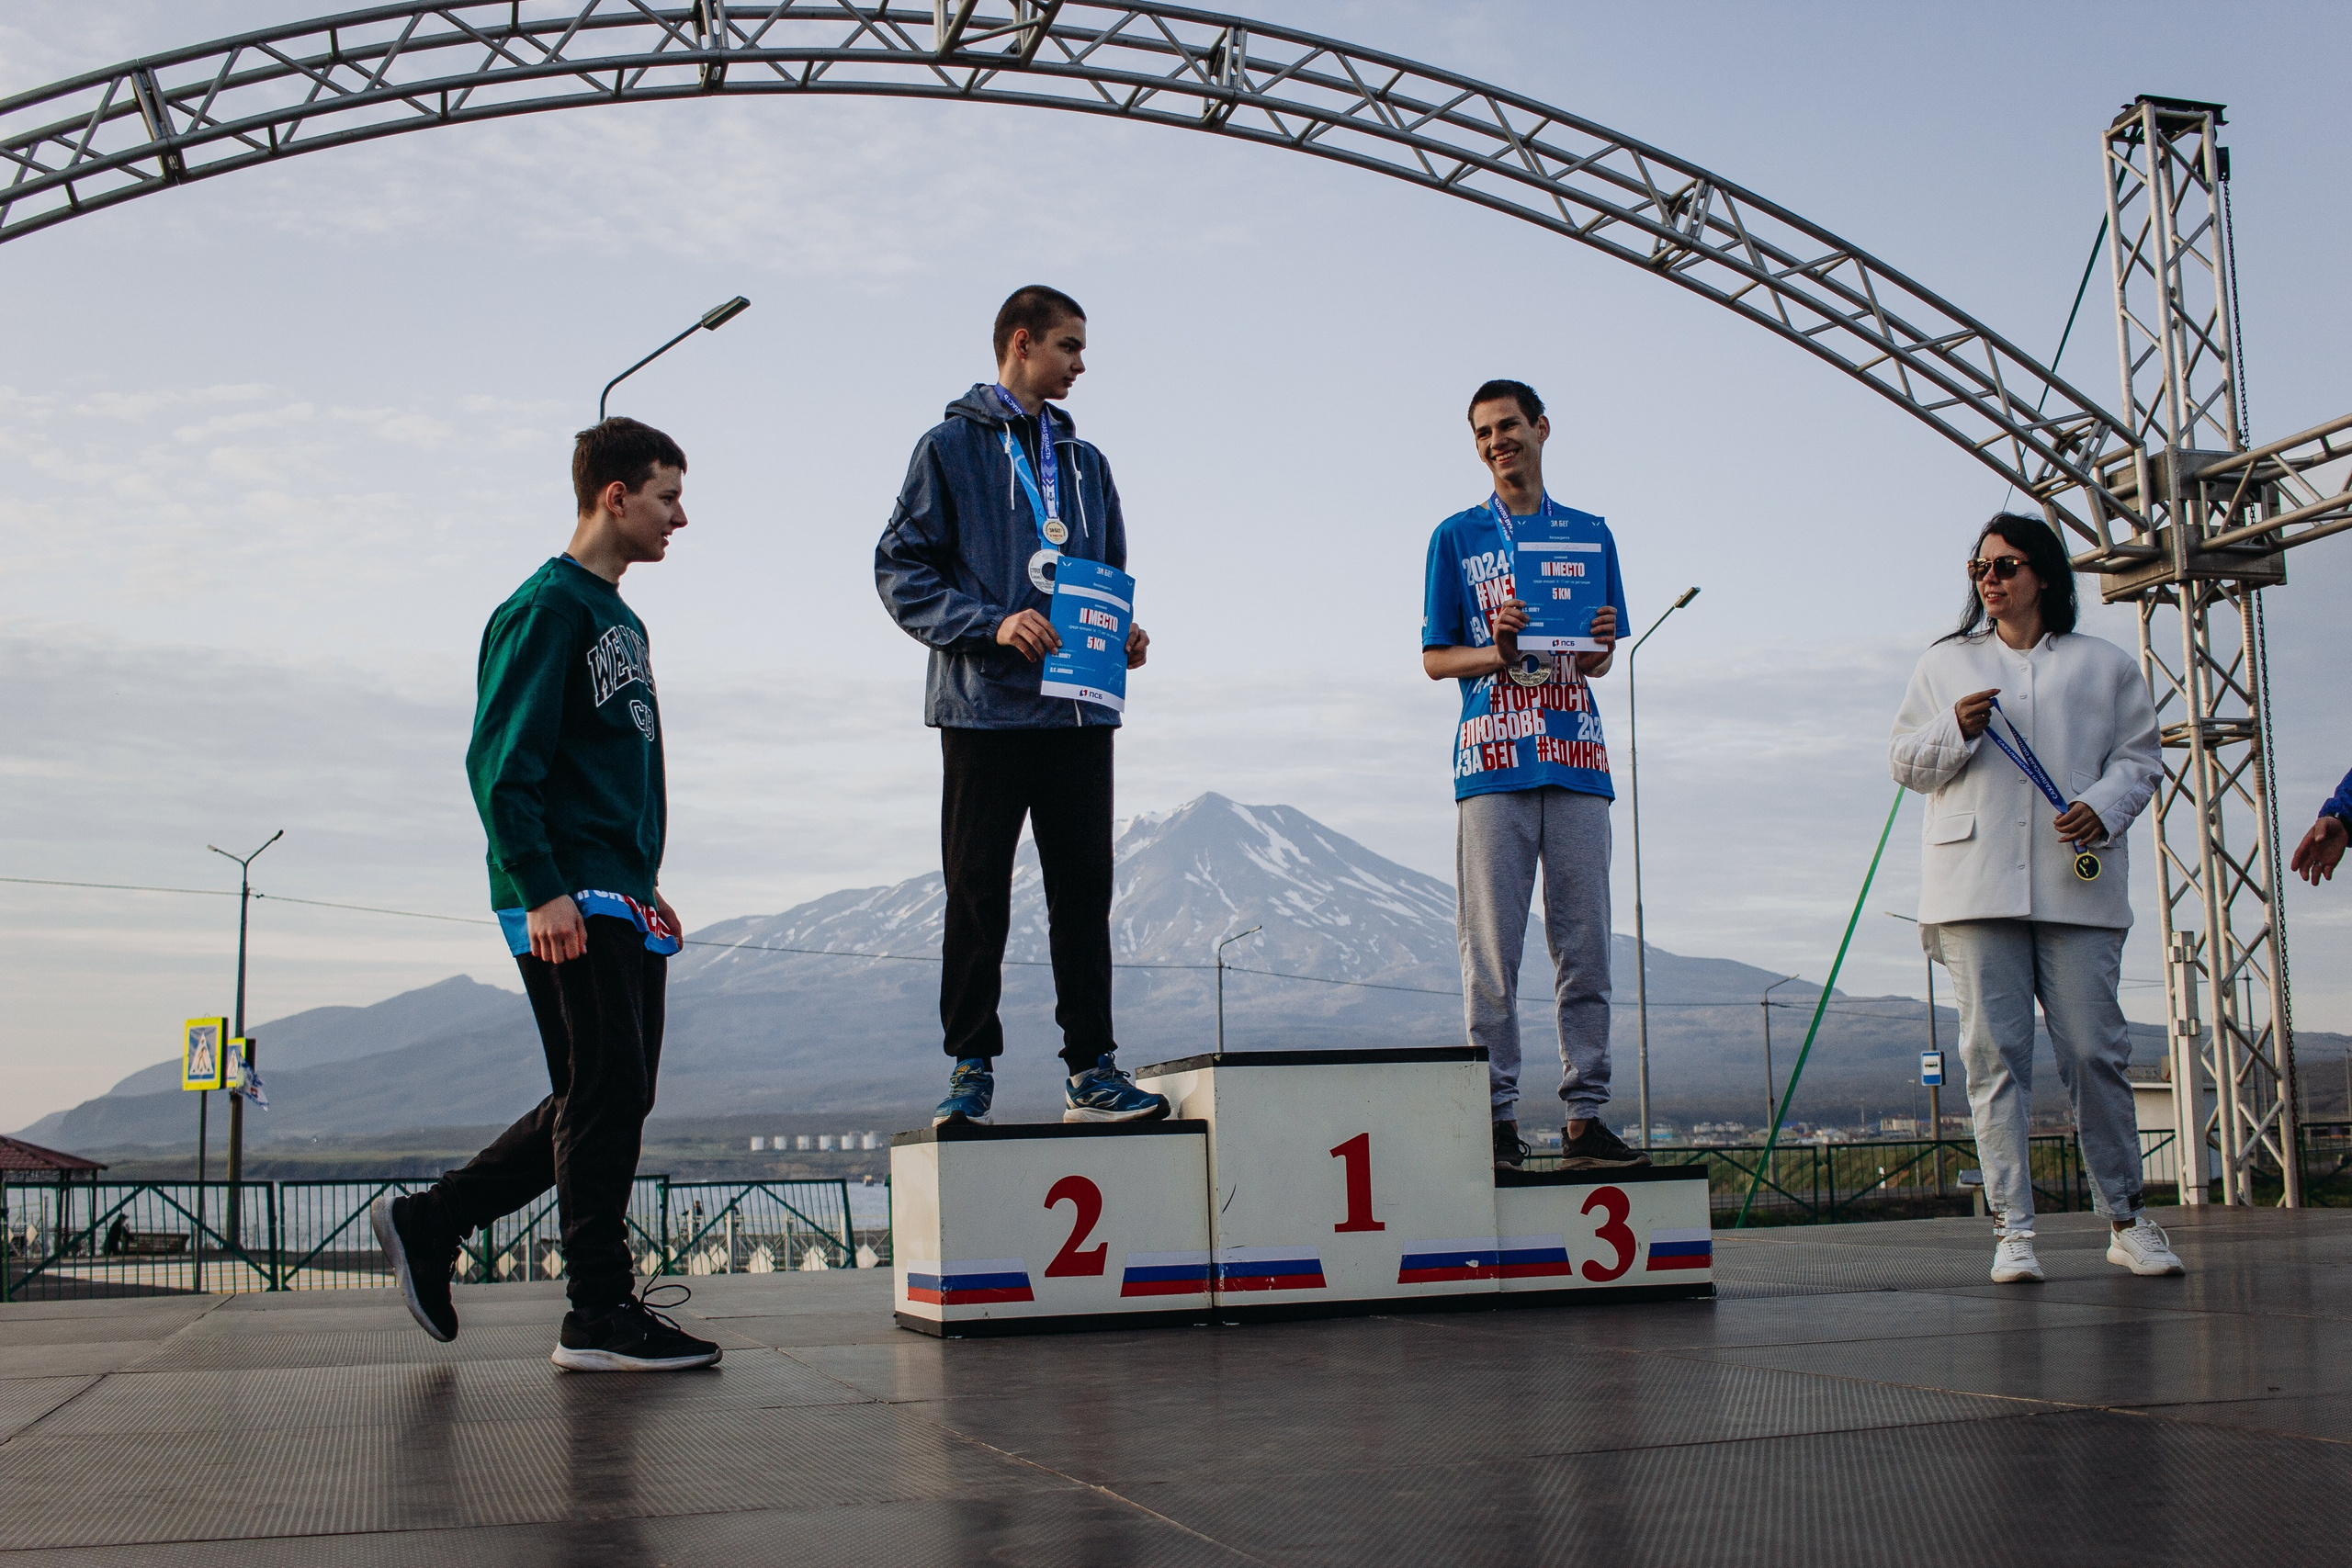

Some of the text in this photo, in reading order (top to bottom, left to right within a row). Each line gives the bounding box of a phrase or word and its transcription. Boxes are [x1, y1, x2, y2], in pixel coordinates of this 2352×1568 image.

[1462, 549, 1510, 586] 2024
[1541, 562, 1585, 577] III МЕСТО
[1552, 588, 1571, 600] 5 КМ
[1080, 607, 1118, 632] II МЕСТО
[1087, 636, 1106, 652] 5 КМ
[1089, 691, 1102, 700] ПСБ
[1460, 708, 1604, 750] #ЛЮБОВЬ 202
[1455, 741, 1519, 780] #ЗАБЕГ
[1997, 739, 2033, 775] САХАЛИНСКАЯ
[2028, 756, 2058, 799] САХАЛИНСКАЯ
[1329, 1132, 1385, 1233] 1
[1043, 1175, 1108, 1277] 2
[1580, 1185, 1636, 1283] 3
